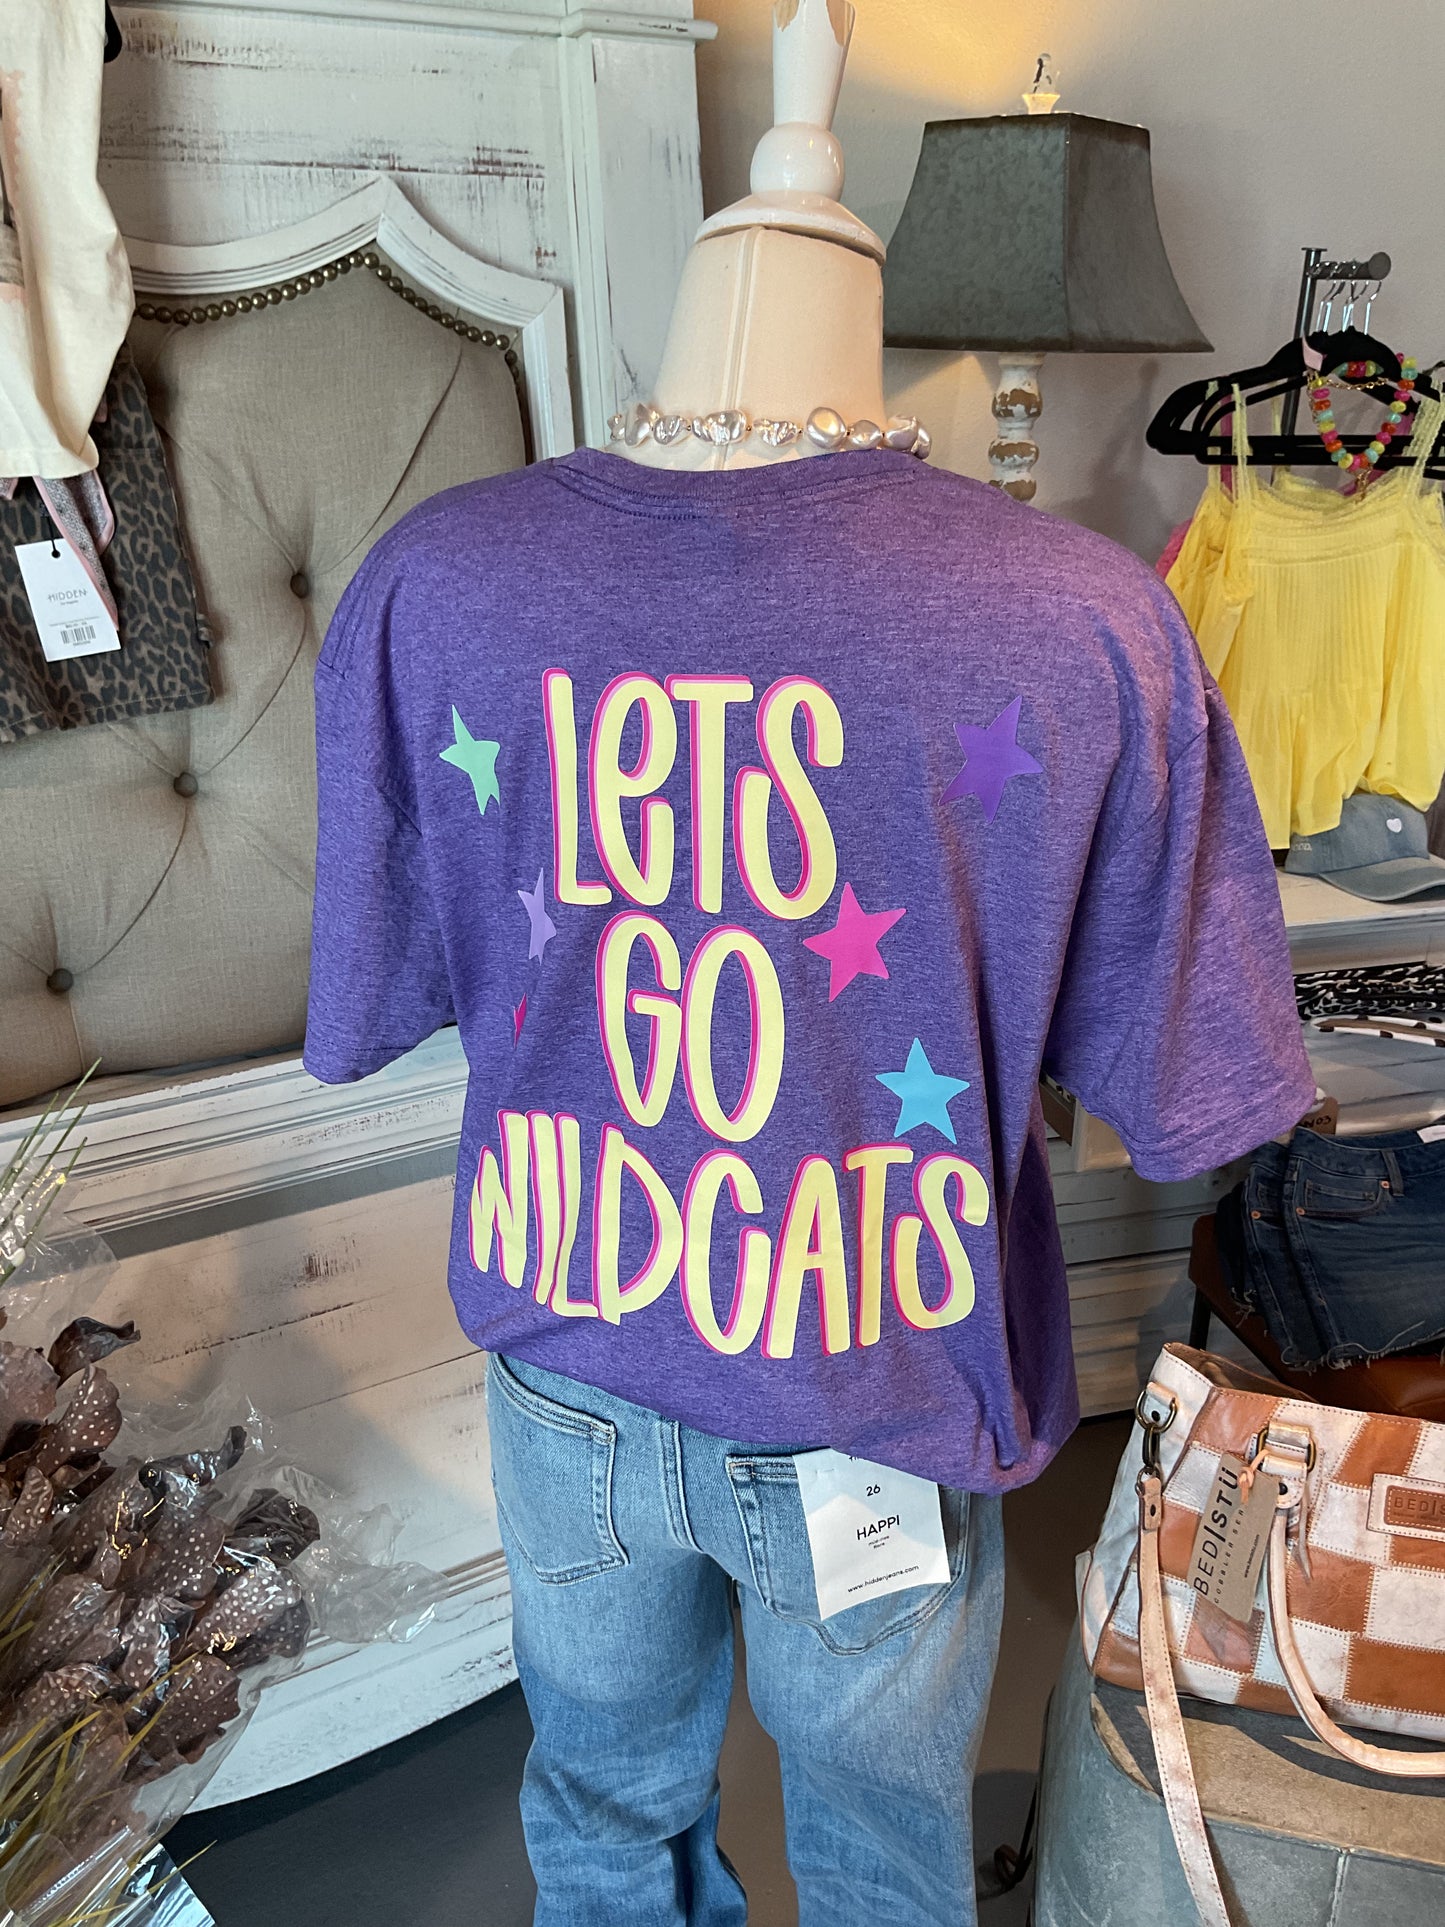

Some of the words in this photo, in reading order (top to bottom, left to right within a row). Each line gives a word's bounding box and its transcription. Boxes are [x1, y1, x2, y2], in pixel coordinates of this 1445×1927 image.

[596, 910, 785, 1142] GO
[468, 1110, 990, 1359] WILDCATS
[866, 1484, 881, 1497] 26
[857, 1514, 900, 1541] HAPPI
[847, 1565, 920, 1593] www.hiddenjeans.com
[1214, 1541, 1234, 1604] COBBLER
